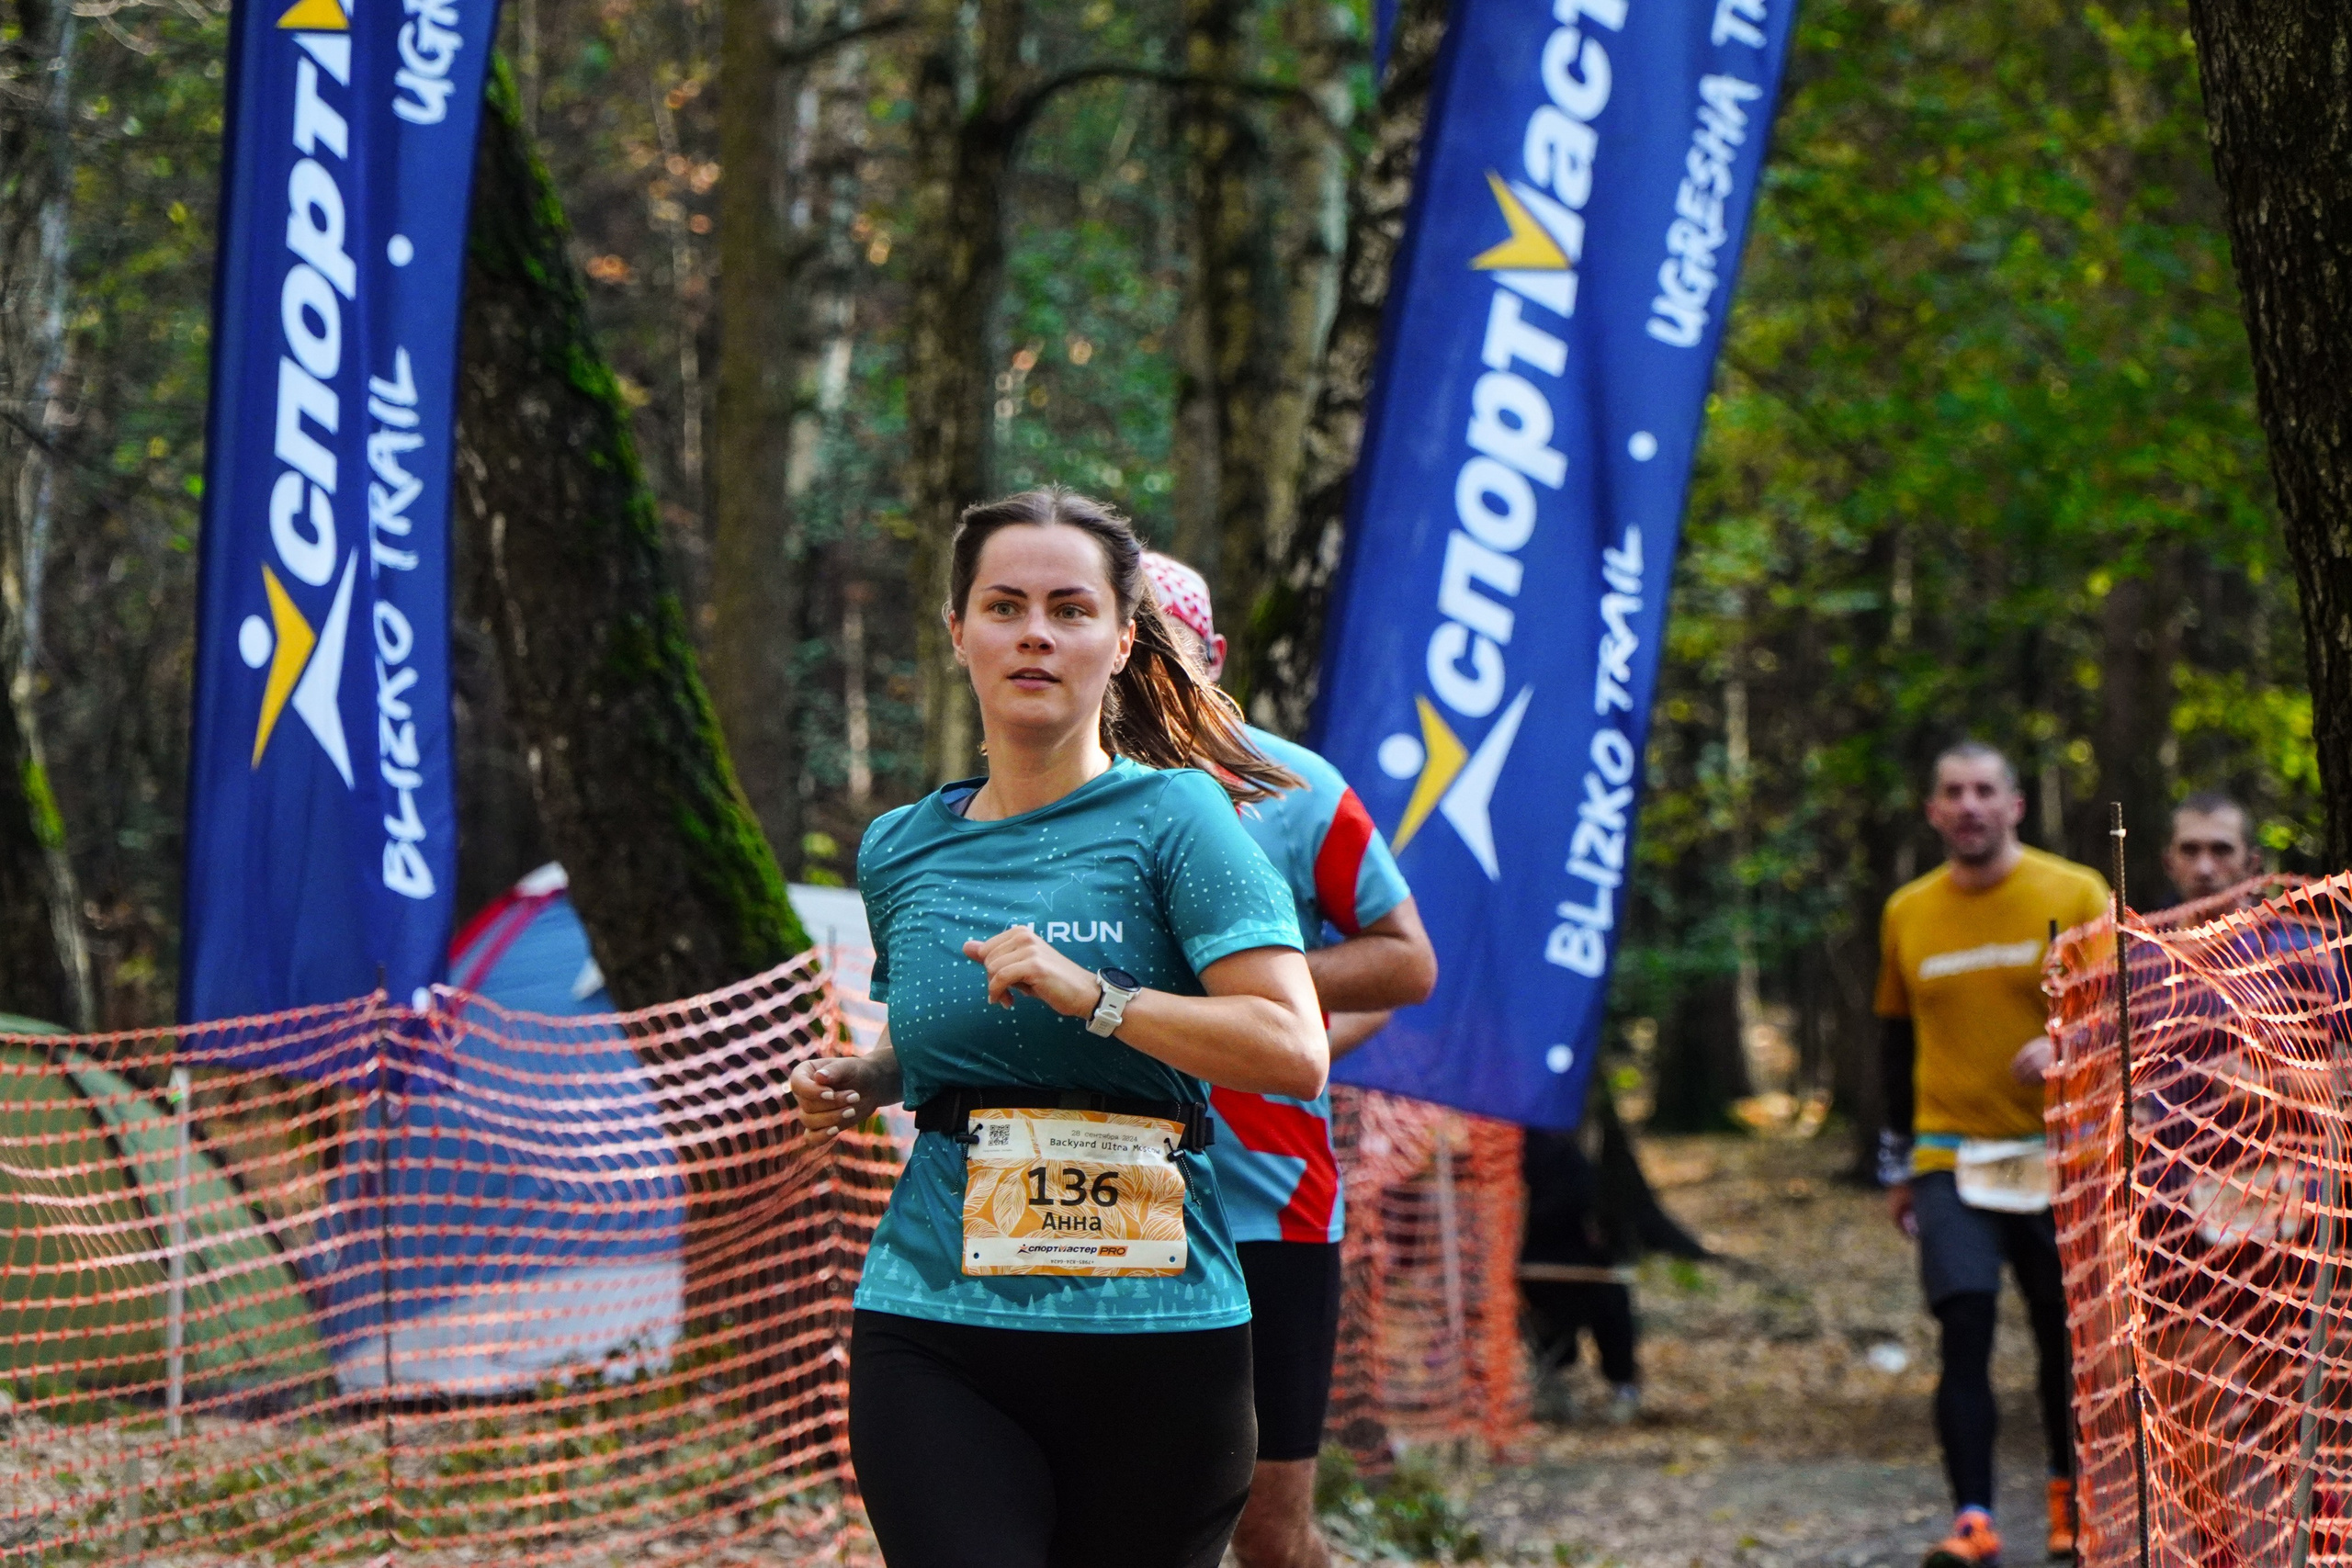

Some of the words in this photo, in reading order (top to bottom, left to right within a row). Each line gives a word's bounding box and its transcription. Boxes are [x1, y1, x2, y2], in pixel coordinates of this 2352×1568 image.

[368, 344, 425, 579] TRAIL
[1545, 728, 1636, 979] BLIZKO
[1594, 524, 1645, 716] TRAIL
[1645, 73, 1764, 348] UGRESHA
[374, 600, 436, 900] BLIZKO
[1046, 920, 1124, 943] RUN
[1049, 1137, 1097, 1149] Backyard
[1101, 1141, 1128, 1152] Ultra
[1085, 1132, 1119, 1140] сентября
[1027, 1166, 1119, 1208] 136
[1041, 1212, 1102, 1232] Анна
[1100, 1247, 1126, 1256] PRO
